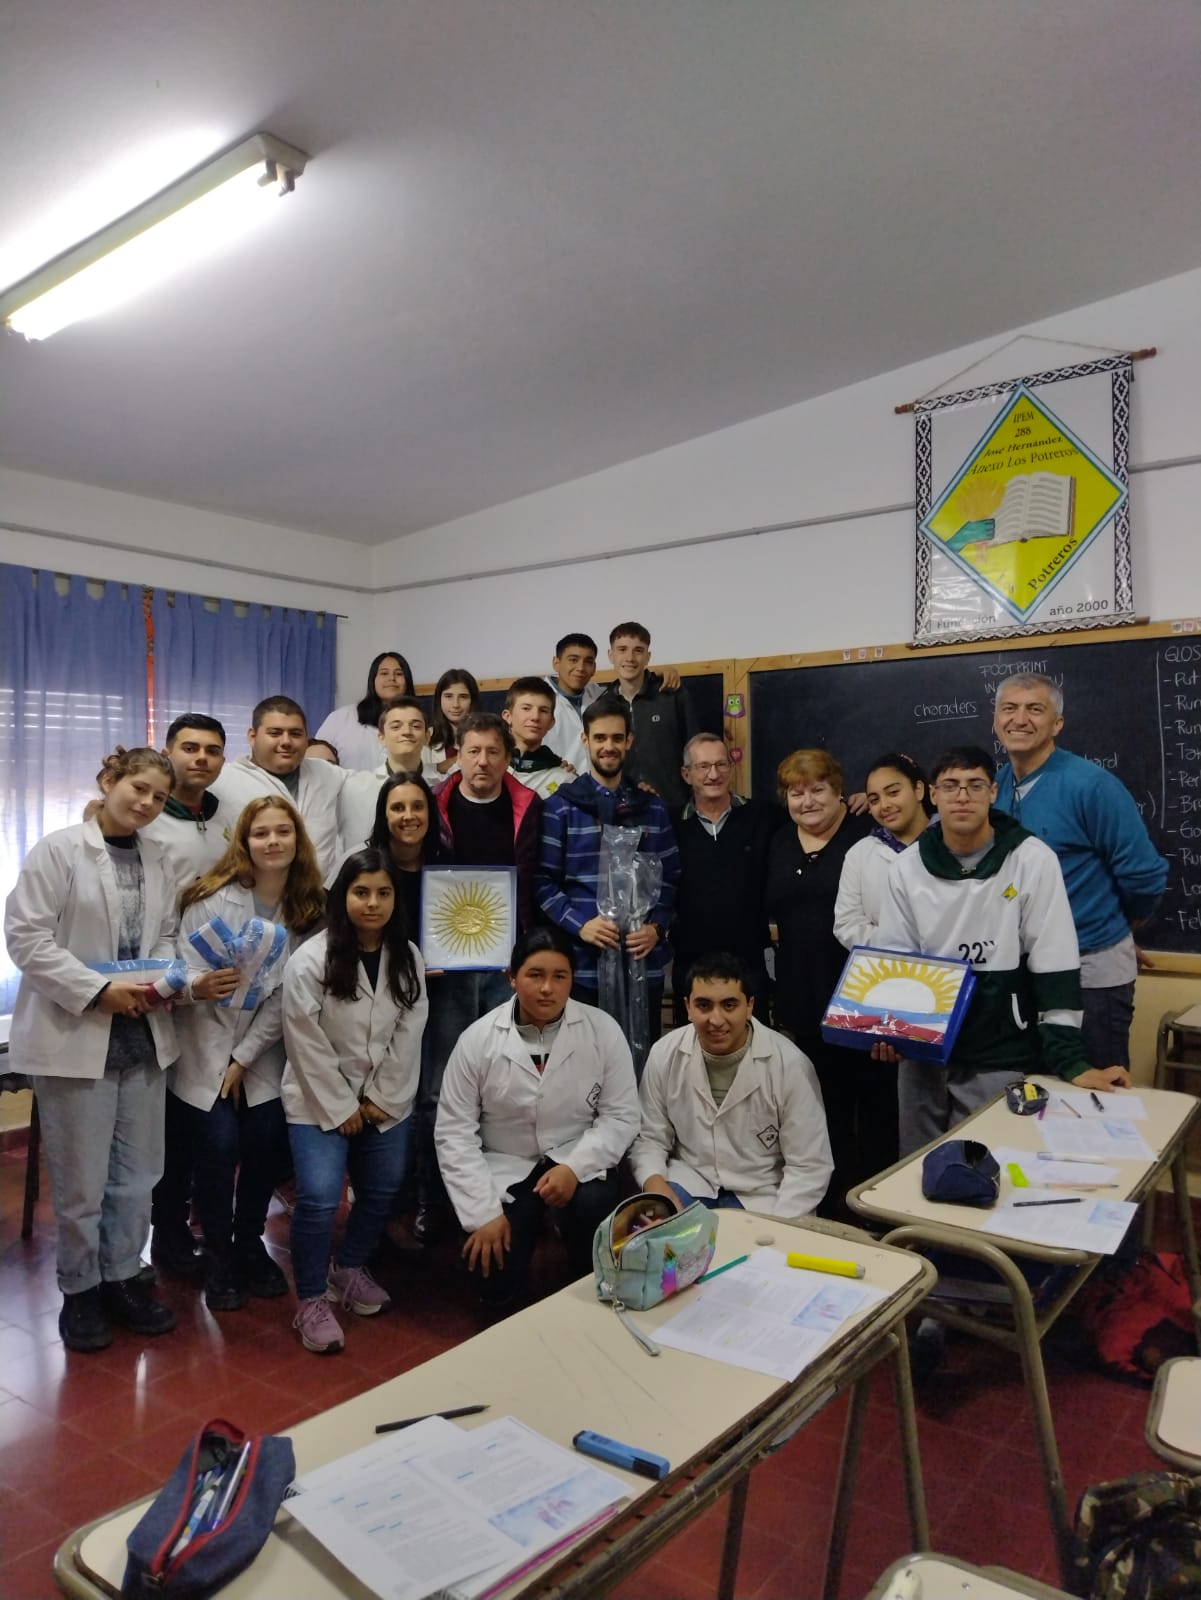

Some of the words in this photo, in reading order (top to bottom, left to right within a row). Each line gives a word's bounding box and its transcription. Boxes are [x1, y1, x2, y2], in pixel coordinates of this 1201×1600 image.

[1013, 411, 1034, 424] IPEM
[970, 461, 1004, 475] Anexo
[1008, 456, 1026, 467] Los
[1031, 447, 1079, 463] Potreros
[1027, 536, 1078, 591] Potreros
[1050, 603, 1073, 616] año
[1077, 599, 1109, 614] 2000
[978, 660, 1048, 678] FOOTPRINT
[1175, 669, 1201, 687] Put
